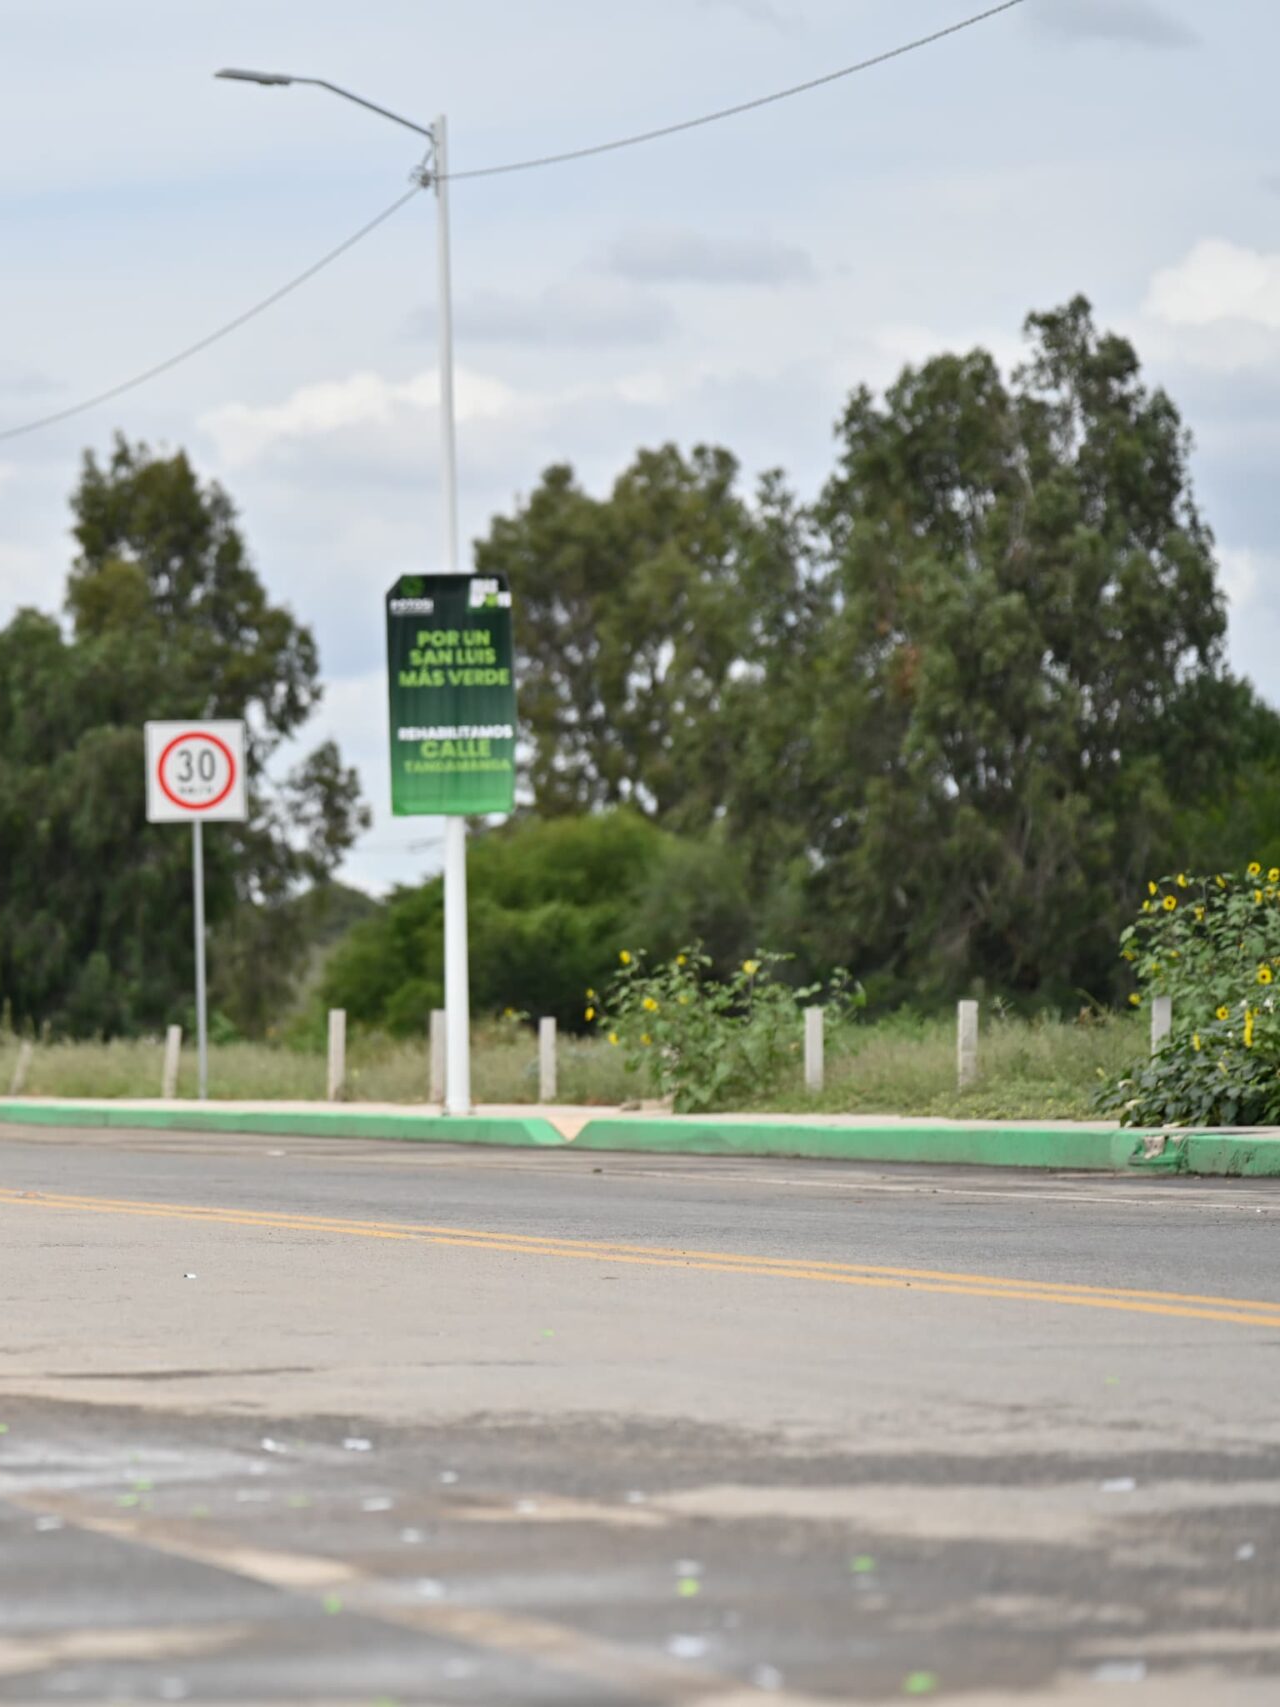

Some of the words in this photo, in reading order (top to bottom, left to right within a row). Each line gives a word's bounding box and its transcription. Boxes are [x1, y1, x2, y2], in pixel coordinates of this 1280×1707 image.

[417, 630, 459, 648] POR
[463, 629, 490, 647] UN
[409, 648, 453, 667] SAN
[456, 647, 496, 665] LUIS
[398, 665, 444, 687] MÁS
[447, 668, 510, 686] VERDE
[397, 724, 514, 741] REHABILITAMOS
[421, 739, 491, 759] CALLE
[178, 748, 216, 783] 30
